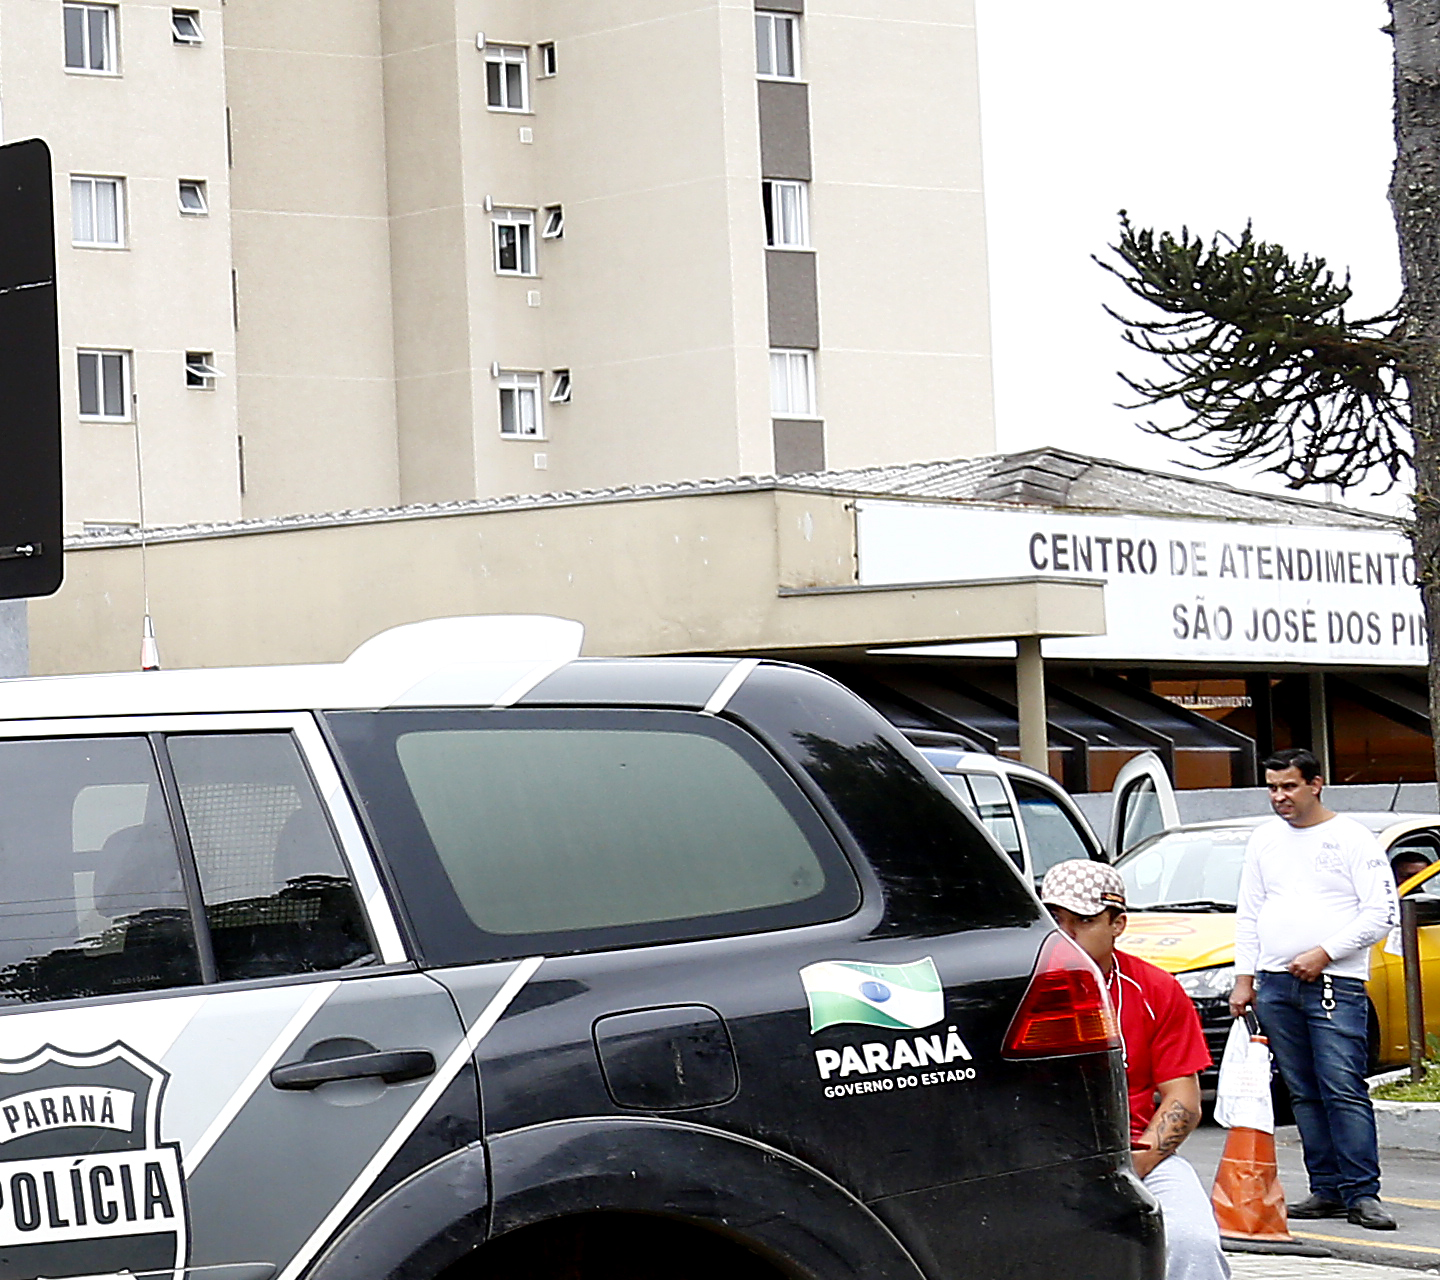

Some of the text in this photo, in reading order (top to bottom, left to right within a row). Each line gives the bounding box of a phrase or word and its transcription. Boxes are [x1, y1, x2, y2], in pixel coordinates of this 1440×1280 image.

[1029, 531, 1417, 586] CENTRO DE ATENDIMENTO
[1172, 595, 1233, 641] SÃO
[1244, 598, 1318, 643] JOSÉ
[1328, 610, 1383, 646] DOS
[815, 1025, 973, 1080] PARANÁ
[824, 1067, 976, 1099] GOVERNO DO ESTADO
[2, 1090, 115, 1134] PARANÁ
